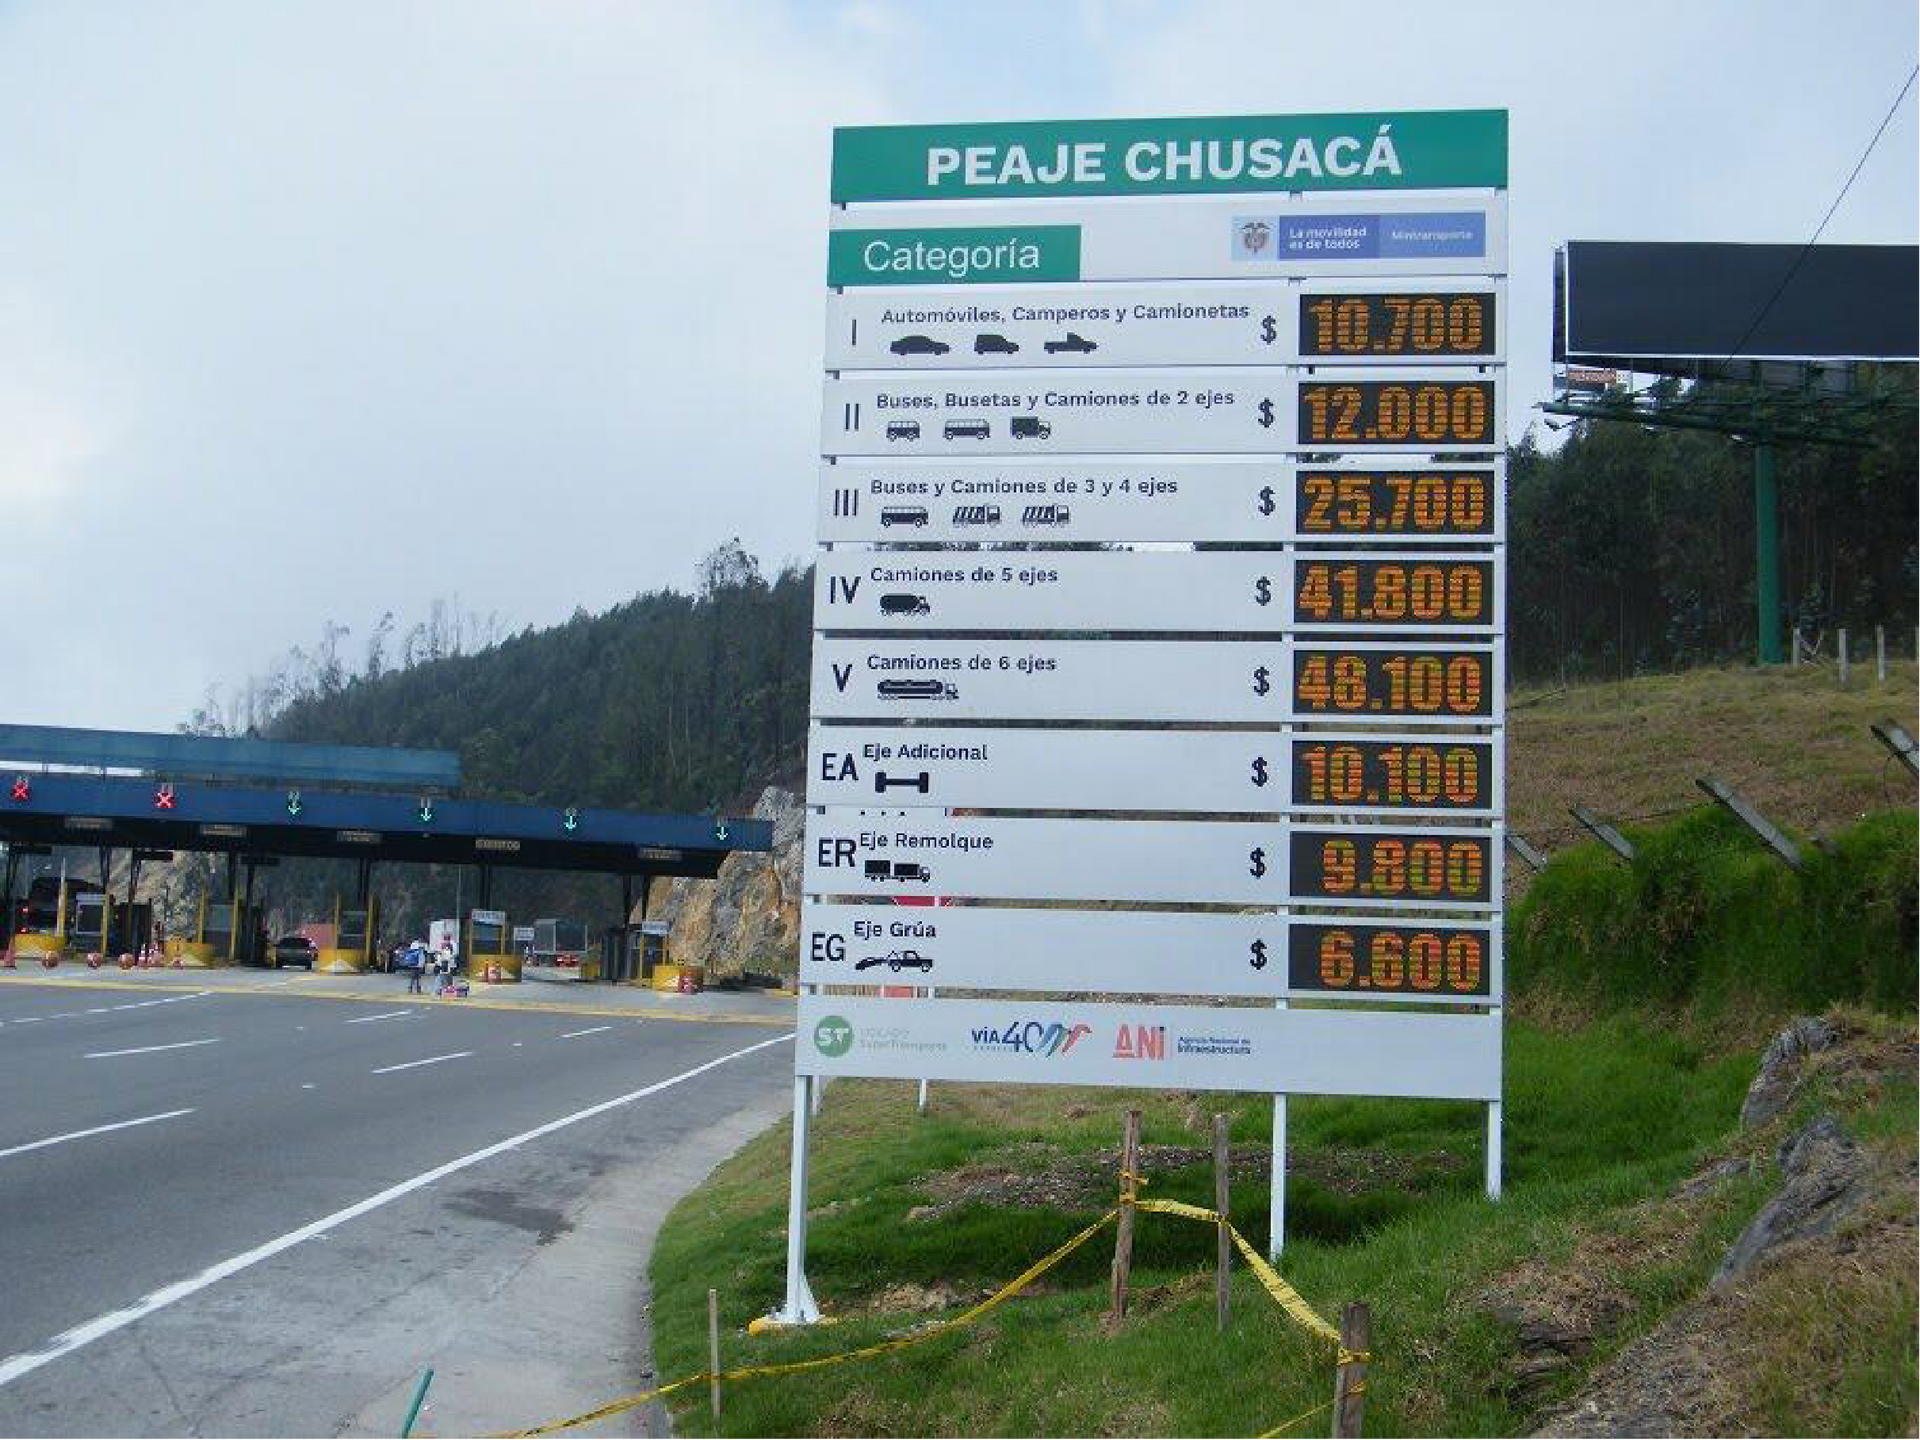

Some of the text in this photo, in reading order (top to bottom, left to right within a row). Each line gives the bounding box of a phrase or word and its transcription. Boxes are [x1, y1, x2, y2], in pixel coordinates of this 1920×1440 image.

[927, 123, 1402, 186] PEAJE CHUSACÁ
[1288, 226, 1368, 240] La movilidad
[1305, 240, 1322, 251] de
[1323, 239, 1361, 250] todos
[864, 237, 1040, 278] Categoría
[880, 302, 1249, 325] Automóviles, Camperos y Camionetas
[1308, 298, 1483, 351] 10.700
[851, 318, 857, 346] I
[1260, 315, 1278, 346] $
[876, 389, 1236, 411] Buses, Busetas y Camiones de 2 ejes
[1257, 397, 1275, 429] $
[1304, 386, 1485, 439] 12.000
[845, 403, 860, 432] II
[834, 488, 859, 517] III
[870, 476, 1179, 498] Buses y Camiones de 3 y 4 ejes
[1257, 485, 1276, 517] $
[1304, 475, 1485, 531] 25.700
[830, 576, 862, 605] IV
[870, 566, 1058, 586] Camiones de 5 ejes
[1255, 575, 1272, 607] $
[1299, 563, 1483, 620] 41.800
[832, 663, 853, 693] V
[866, 653, 1056, 674] Camiones de 6 ejes
[1253, 666, 1270, 697] $
[1299, 655, 1483, 712] 48.100
[821, 752, 860, 782] EA
[863, 742, 988, 762] Eje Adicional
[1251, 756, 1268, 788] $
[1302, 745, 1479, 804] 10.100
[818, 838, 857, 868] ER
[860, 830, 994, 853] Eje Remolque
[1249, 847, 1267, 880] $
[1321, 840, 1483, 894] 9.800
[854, 920, 937, 941] Eje Grúa
[811, 931, 845, 962] EG
[1249, 939, 1268, 971] $
[1319, 929, 1481, 989] 6.600
[818, 1027, 850, 1047] ST
